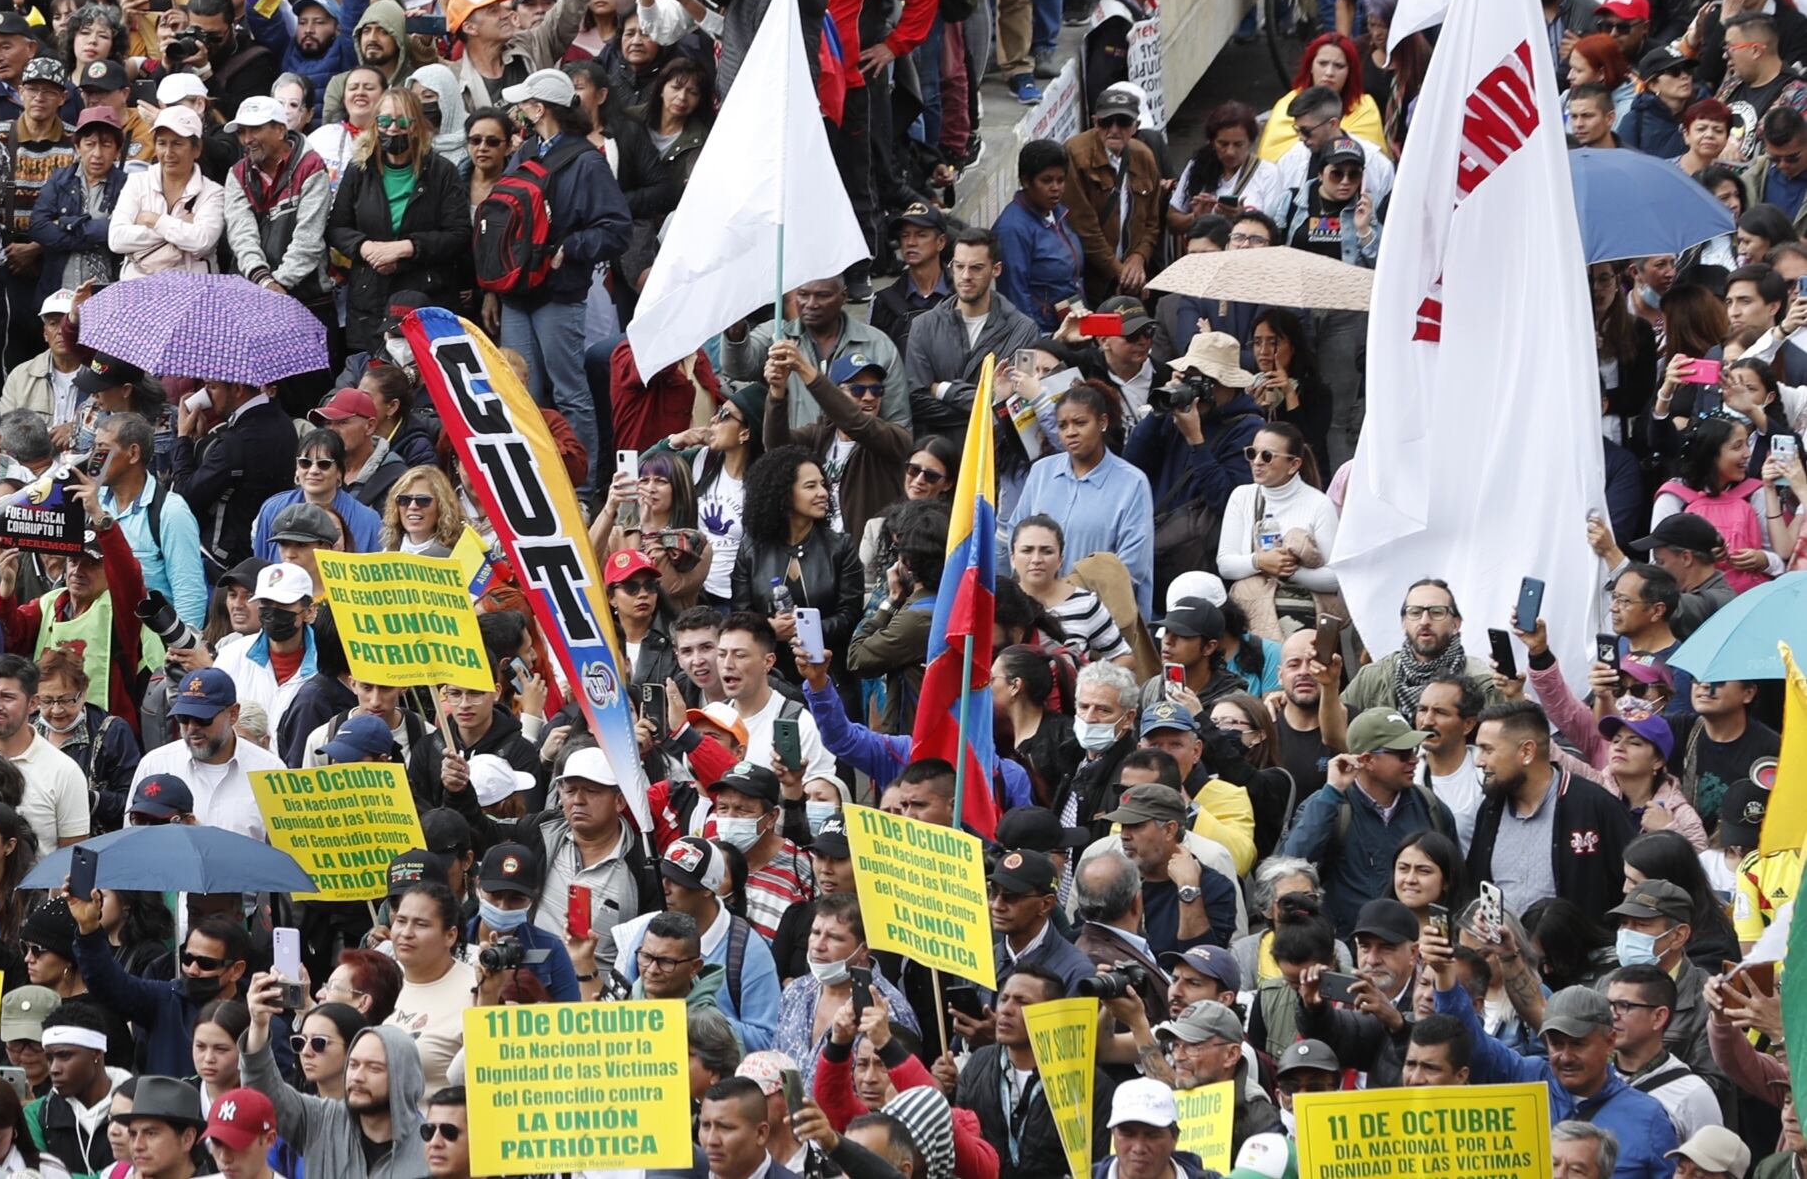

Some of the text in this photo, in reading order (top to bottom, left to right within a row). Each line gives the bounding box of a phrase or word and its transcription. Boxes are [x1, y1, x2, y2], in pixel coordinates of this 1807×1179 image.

[430, 333, 603, 647] CUT
[5, 506, 66, 525] FUERA FISCAL
[7, 520, 53, 536] CORRUPTO
[321, 560, 463, 588] SOY SOBREVIVIENTE
[330, 587, 469, 611] DEL GENOCIDIO CONTRA
[352, 610, 460, 637] LA UNIÓN
[348, 639, 482, 669] PATRIÓTICA
[265, 766, 396, 795] 11 De Octubre
[283, 793, 393, 812] Día Nacional por la
[270, 810, 414, 831] Dignidad de las Víctimas
[290, 831, 411, 848] del Genocidio contra
[859, 810, 973, 863] 11 De Octubre
[312, 853, 336, 868] LA
[859, 855, 906, 882] Dignidad
[907, 868, 920, 886] de
[922, 873, 939, 891] las
[892, 844, 937, 872] Nacional
[938, 860, 957, 877] por
[958, 864, 968, 881] la
[312, 870, 387, 889] PATRIÓT
[874, 879, 977, 924] del Genocidio contra
[893, 903, 965, 943] LA UNIÓN
[886, 923, 978, 970] PATRIÓTICA
[484, 1006, 664, 1038] 11 De Octubre
[499, 1038, 652, 1061] Día Nacional por la
[476, 1061, 678, 1085] Dignidad de las Víctimas
[492, 1085, 663, 1108] del Genocidio contra
[517, 1106, 638, 1133] LA UNIÓN
[1327, 1107, 1517, 1141] 11 DE OCTUBRE
[501, 1134, 658, 1160] PATRIÓTICA
[1335, 1134, 1514, 1161] DÍA NACIONAL POR LA
[1320, 1152, 1532, 1179] DIGNIDAD DE LAS VÍCTIMAS
